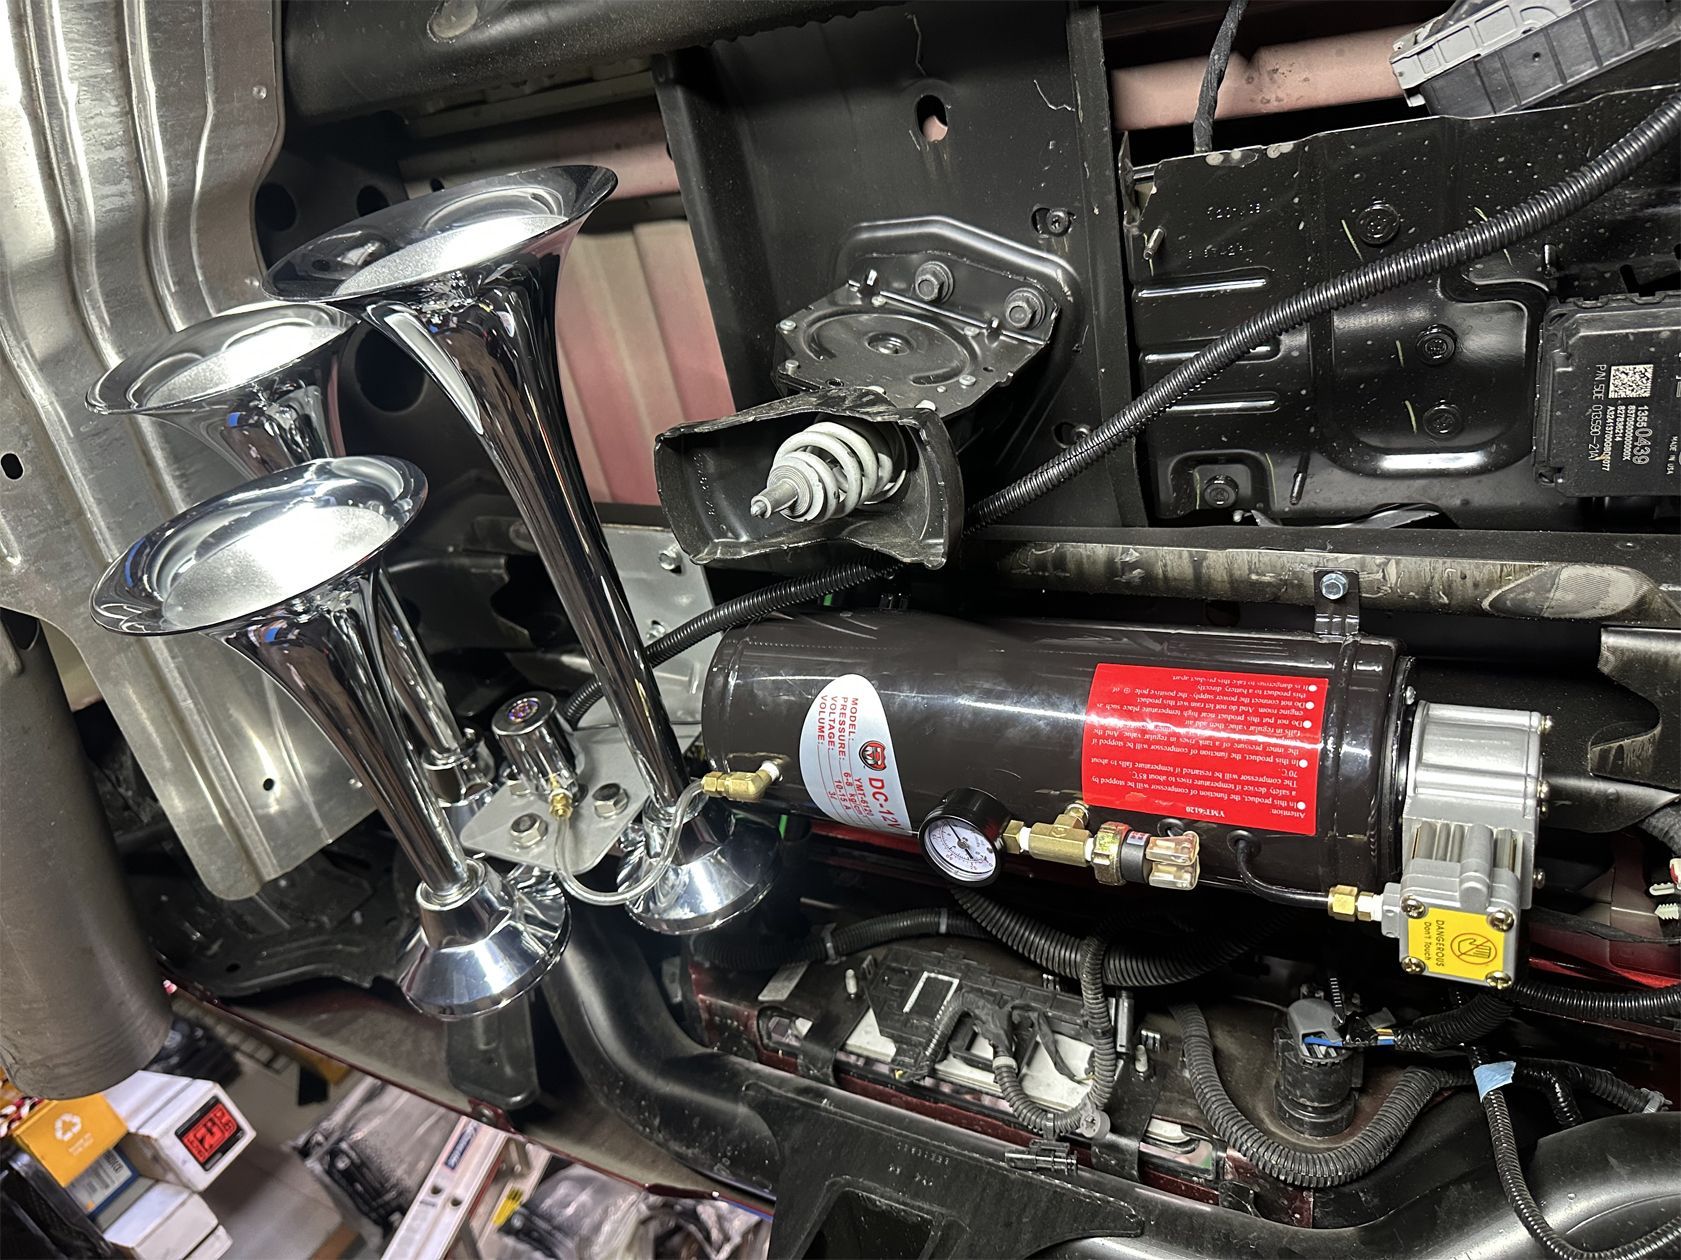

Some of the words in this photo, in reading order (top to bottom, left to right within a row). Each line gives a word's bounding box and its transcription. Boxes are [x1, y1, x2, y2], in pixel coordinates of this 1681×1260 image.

[1632, 405, 1653, 464] 13550439
[1669, 436, 1678, 452] MADE
[1666, 463, 1674, 475] USA
[1224, 685, 1247, 694] battery
[1256, 681, 1293, 689] dangerous
[1141, 706, 1180, 716] temperature
[1182, 709, 1198, 718] high
[817, 695, 828, 745] VOLUME:
[848, 697, 858, 741] MODEL:
[1248, 725, 1274, 735] regular
[1274, 727, 1284, 736] in
[1284, 729, 1300, 737] falls
[838, 696, 848, 761] PRESSURE:
[844, 772, 853, 786] 6-8
[1143, 732, 1167, 741] regular
[1098, 738, 1124, 746] stopped
[1233, 742, 1263, 751] pressure
[827, 696, 838, 750] VOLTAGE:
[834, 780, 846, 803] 10-15
[1150, 744, 1188, 753] compressor
[1287, 748, 1299, 756] the
[1199, 750, 1228, 759] function
[1230, 752, 1242, 760] the
[1118, 760, 1132, 768] falls
[1275, 757, 1289, 765] this
[1291, 759, 1299, 767] In
[1134, 762, 1173, 772] temperature
[1182, 768, 1212, 776] restarted
[1091, 775, 1099, 784] by
[1100, 777, 1125, 785] stopped
[1148, 774, 1167, 782] about
[1240, 774, 1281, 784] compressor
[1193, 779, 1234, 789] temperature
[1283, 779, 1297, 788] The
[1151, 784, 1188, 793] compressor
[1243, 785, 1267, 794] device
[1269, 786, 1290, 796] safety
[1199, 790, 1228, 800] function
[868, 777, 902, 830] DC-12V
[1436, 920, 1445, 967] DANGEROUS
